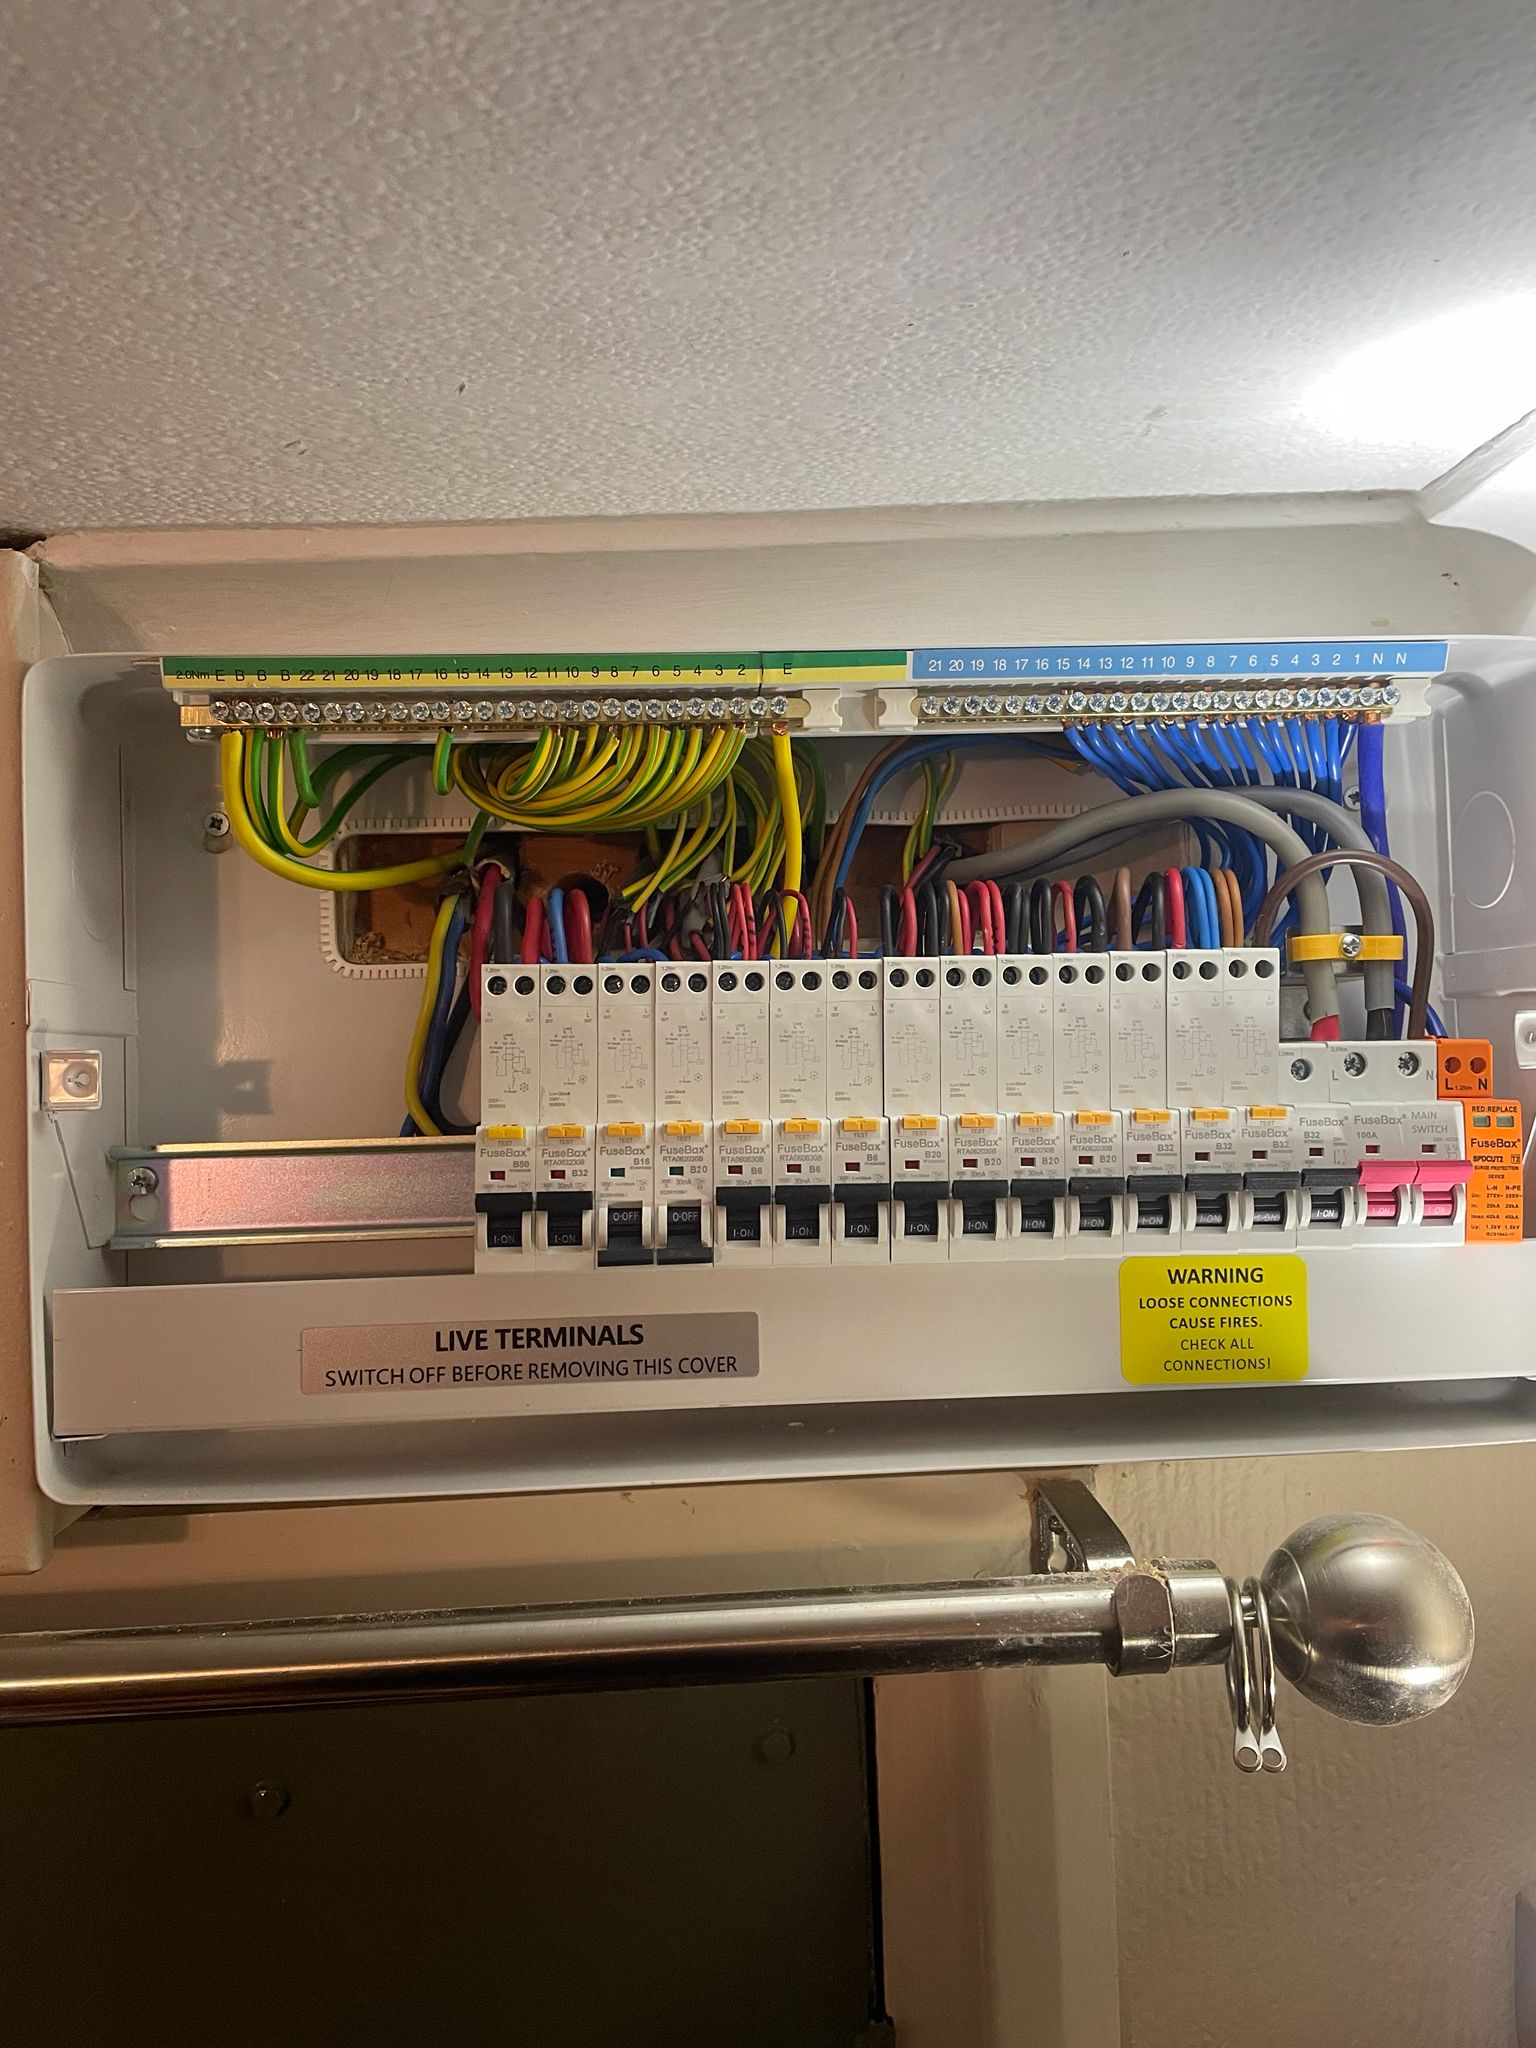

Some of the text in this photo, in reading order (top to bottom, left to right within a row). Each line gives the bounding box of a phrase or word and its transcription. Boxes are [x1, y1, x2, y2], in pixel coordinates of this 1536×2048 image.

[929, 653, 1407, 672] 21 20 19 18 17 16 15 14 13 12 11 10 9 8 7 6 5 4 3 2 1 N N
[176, 671, 209, 680] 2.0Nm
[216, 670, 225, 681] E
[235, 670, 245, 681] B
[257, 670, 267, 681] B
[281, 670, 290, 681] B
[300, 670, 315, 681] 22
[323, 669, 336, 681] 21
[344, 669, 359, 681] 20
[365, 669, 379, 680] 19
[387, 669, 401, 680] 18
[409, 668, 423, 680] 17
[434, 668, 448, 680] 16
[456, 668, 470, 679] 15
[477, 667, 490, 679] 14
[500, 667, 513, 679] 13
[525, 667, 538, 679] 12
[546, 667, 558, 678] 11
[566, 667, 579, 678] 10
[591, 667, 599, 678] 9
[611, 666, 618, 677] 8
[631, 666, 639, 677] 7
[652, 665, 660, 677] 6
[673, 665, 681, 676] 5
[694, 665, 702, 676] 4
[715, 665, 723, 676] 3
[738, 664, 746, 676] 2
[783, 663, 792, 675] E
[1331, 1070, 1339, 1081] L
[1426, 1071, 1434, 1081] N
[1445, 1078, 1454, 1090] L
[1478, 1078, 1488, 1090] N
[1411, 1111, 1437, 1120] MAIN
[1304, 1131, 1320, 1139] B32
[1357, 1131, 1378, 1139] 100A
[1411, 1125, 1448, 1134] SWITCH
[1272, 1141, 1289, 1149] B32
[925, 1151, 941, 1159] B20
[1100, 1155, 1117, 1163] B20
[984, 1158, 1001, 1166] B20
[1042, 1157, 1059, 1165] B20
[690, 1166, 708, 1174] B20
[751, 1167, 763, 1175] B6
[1167, 1267, 1264, 1285] WARNING
[1139, 1295, 1293, 1309] LOOSE CONNECTIONS
[1169, 1316, 1263, 1329] CAUSE FIRES.
[435, 1324, 645, 1352] LIVE TERMINALS
[1180, 1338, 1254, 1351] CHECK ALL
[1163, 1357, 1271, 1372] CONNECTIONS!
[325, 1356, 738, 1387] SWITCH OFF BEFORE REMOVING THIS COVER
